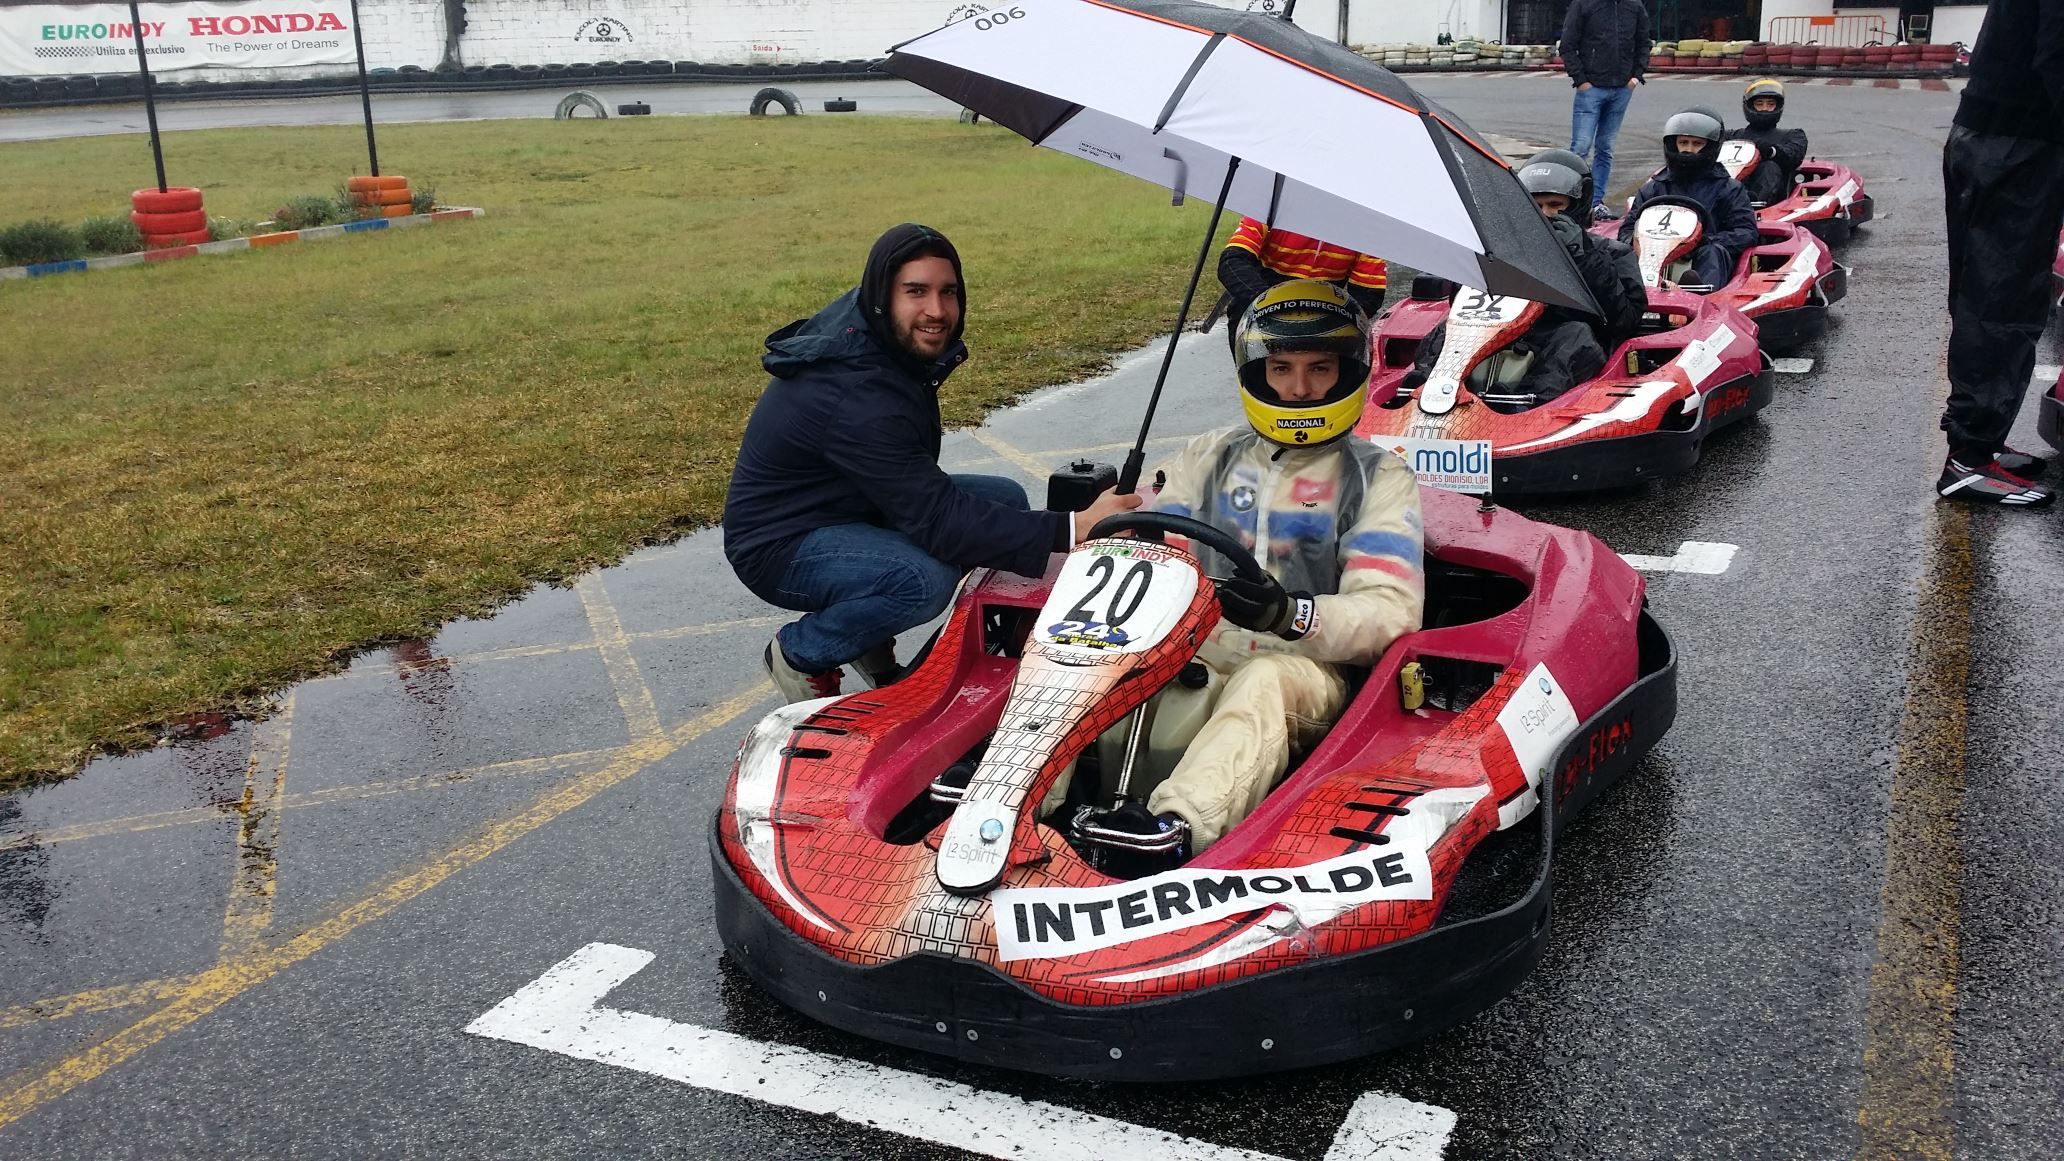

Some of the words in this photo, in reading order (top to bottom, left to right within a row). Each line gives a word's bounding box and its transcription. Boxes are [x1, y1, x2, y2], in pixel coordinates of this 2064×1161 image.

[187, 12, 348, 37] HONDA
[974, 6, 1026, 31] 006
[41, 22, 166, 41] EUROINDY
[603, 16, 634, 42] KARTING
[96, 46, 126, 56] Utiliza
[145, 44, 185, 55] exclusivo
[207, 42, 231, 52] The
[234, 41, 273, 52] Power
[277, 41, 289, 50] of
[292, 39, 340, 49] Dreams
[1734, 145, 1743, 160] 7
[1658, 210, 1673, 231] 4
[1251, 303, 1281, 321] DRIVEN
[1284, 301, 1297, 309] TO
[1299, 300, 1353, 319] PERFECTION
[1277, 419, 1324, 428] NACIONAL
[1416, 443, 1488, 474] moldi
[1416, 474, 1443, 483] MOLDES
[1090, 545, 1173, 564] EUROINDY
[1063, 555, 1154, 627] 20
[1057, 620, 1111, 639] 24
[1050, 634, 1063, 643] da
[1069, 636, 1118, 648] Batalha
[1013, 853, 1413, 943] INTERMOLDE
